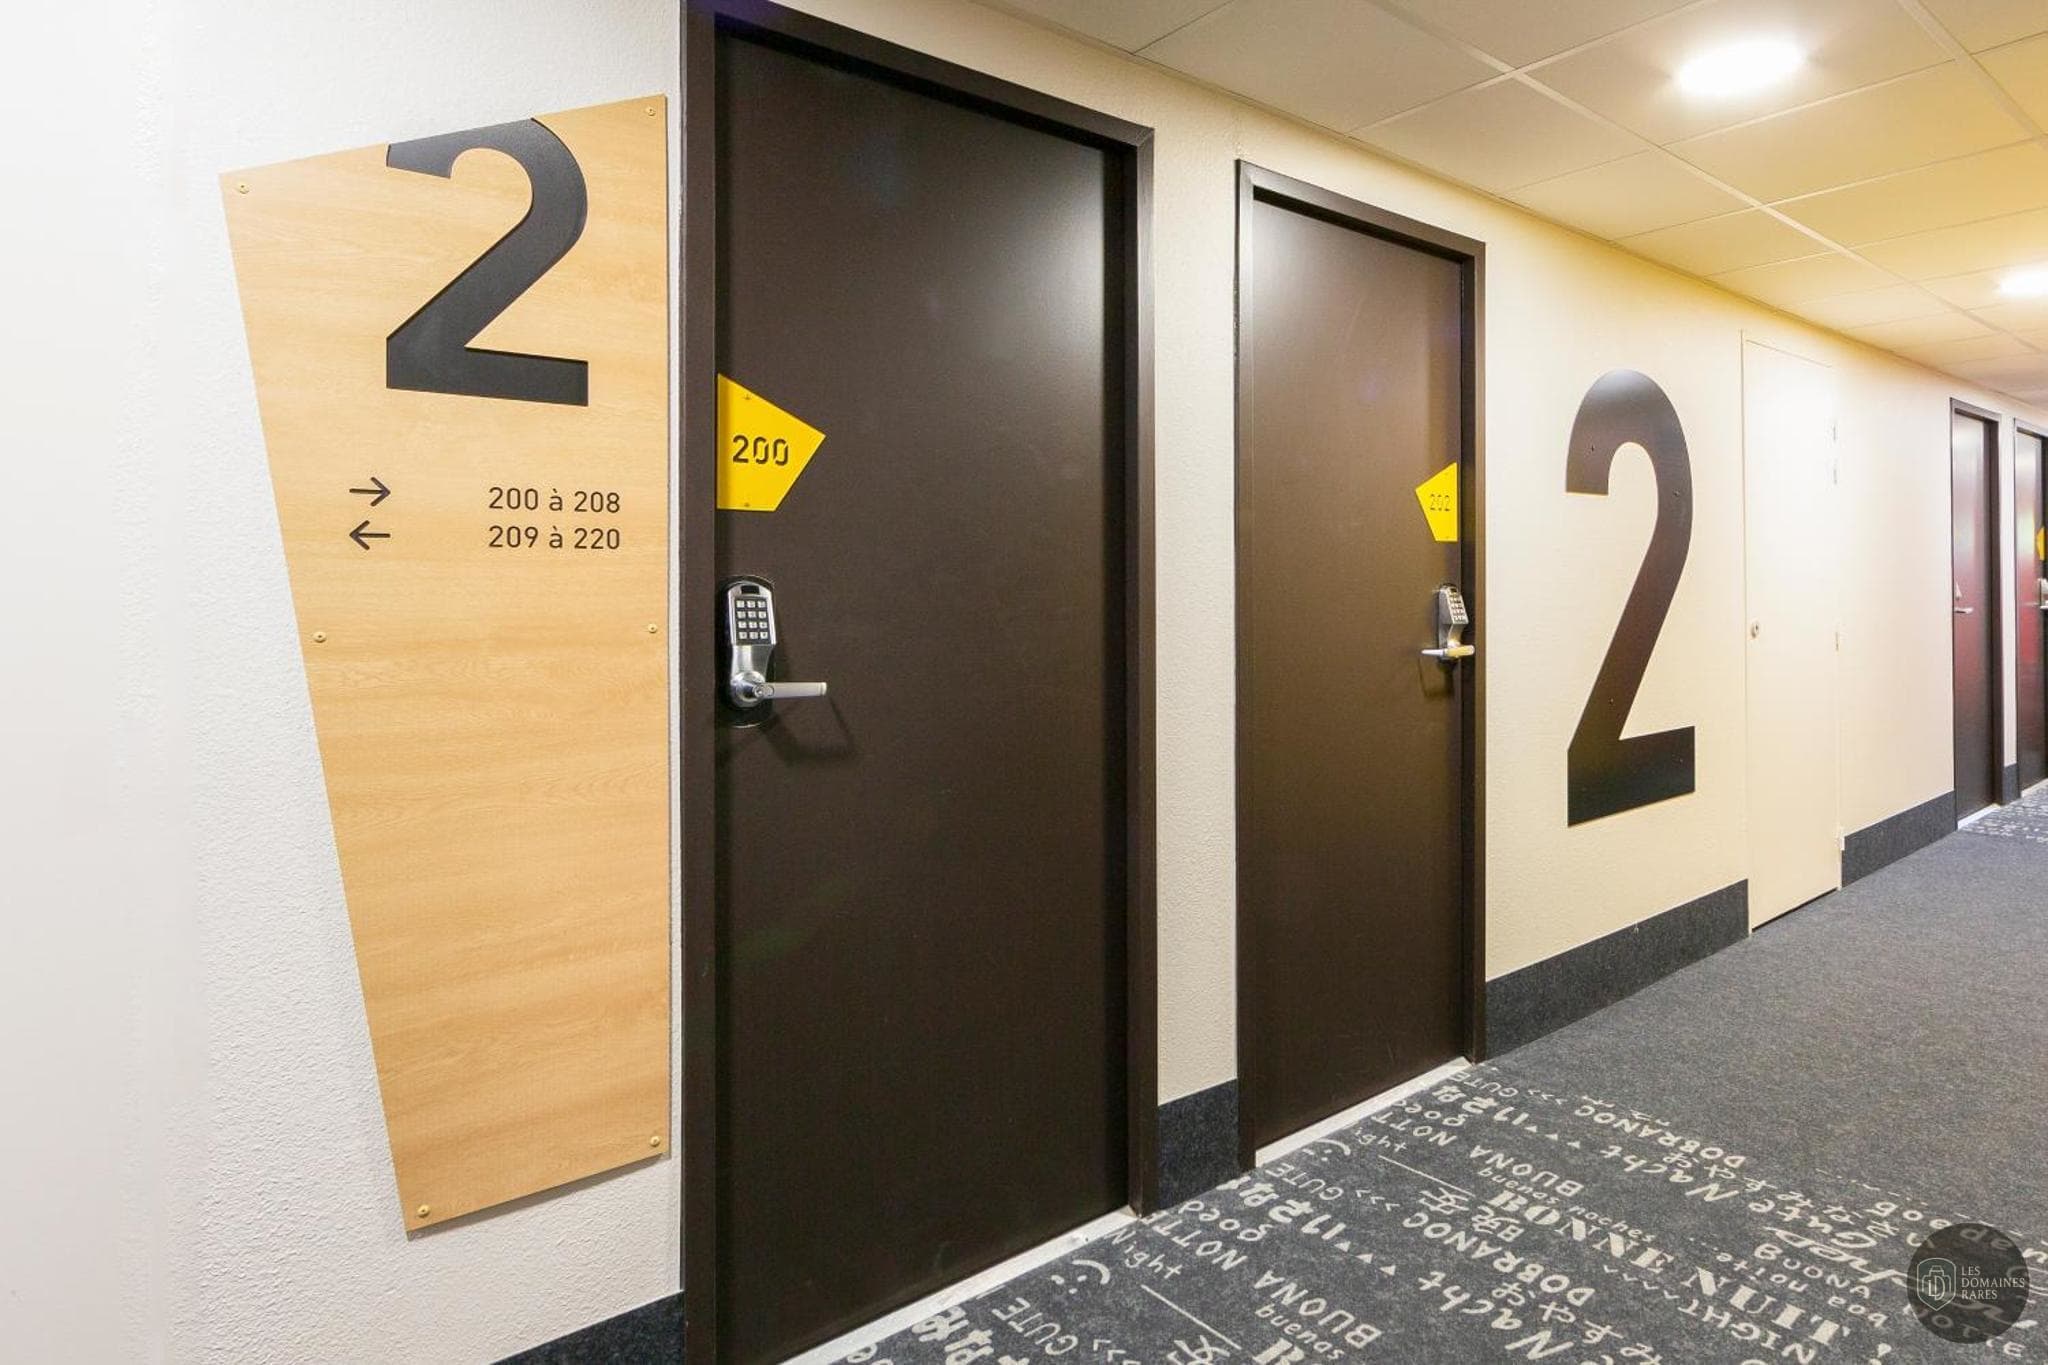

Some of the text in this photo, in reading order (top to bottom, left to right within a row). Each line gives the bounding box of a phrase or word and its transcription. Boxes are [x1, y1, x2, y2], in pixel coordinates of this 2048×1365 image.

[386, 118, 589, 407] 2
[732, 434, 789, 466] 200
[488, 486, 620, 514] 200 à 208
[1429, 493, 1450, 512] 202
[488, 525, 620, 550] 209 à 220
[1566, 369, 1696, 827] 2
[1449, 1070, 1519, 1098] GUTE
[1354, 1126, 1406, 1153] ight
[1370, 1111, 1584, 1197] BUONA NOTT
[1574, 1105, 1746, 1168] DOBRANOC
[1264, 1162, 1344, 1201] GUTE
[1477, 1166, 1656, 1243] buenas noches
[1600, 1145, 1876, 1249] Gute Nacht
[1402, 1212, 1595, 1307] DOBRANOC
[1488, 1190, 1674, 1274] BONNE
[1681, 1266, 1851, 1346] NUIT
[991, 1297, 1078, 1356] GUTE
[1253, 1270, 1383, 1349] BUONA
[1255, 1303, 1345, 1360] buenas
[1418, 1270, 1574, 1360] Nacht
[1677, 1298, 1816, 1365] NIGHT
[1827, 1295, 1888, 1328] boa
